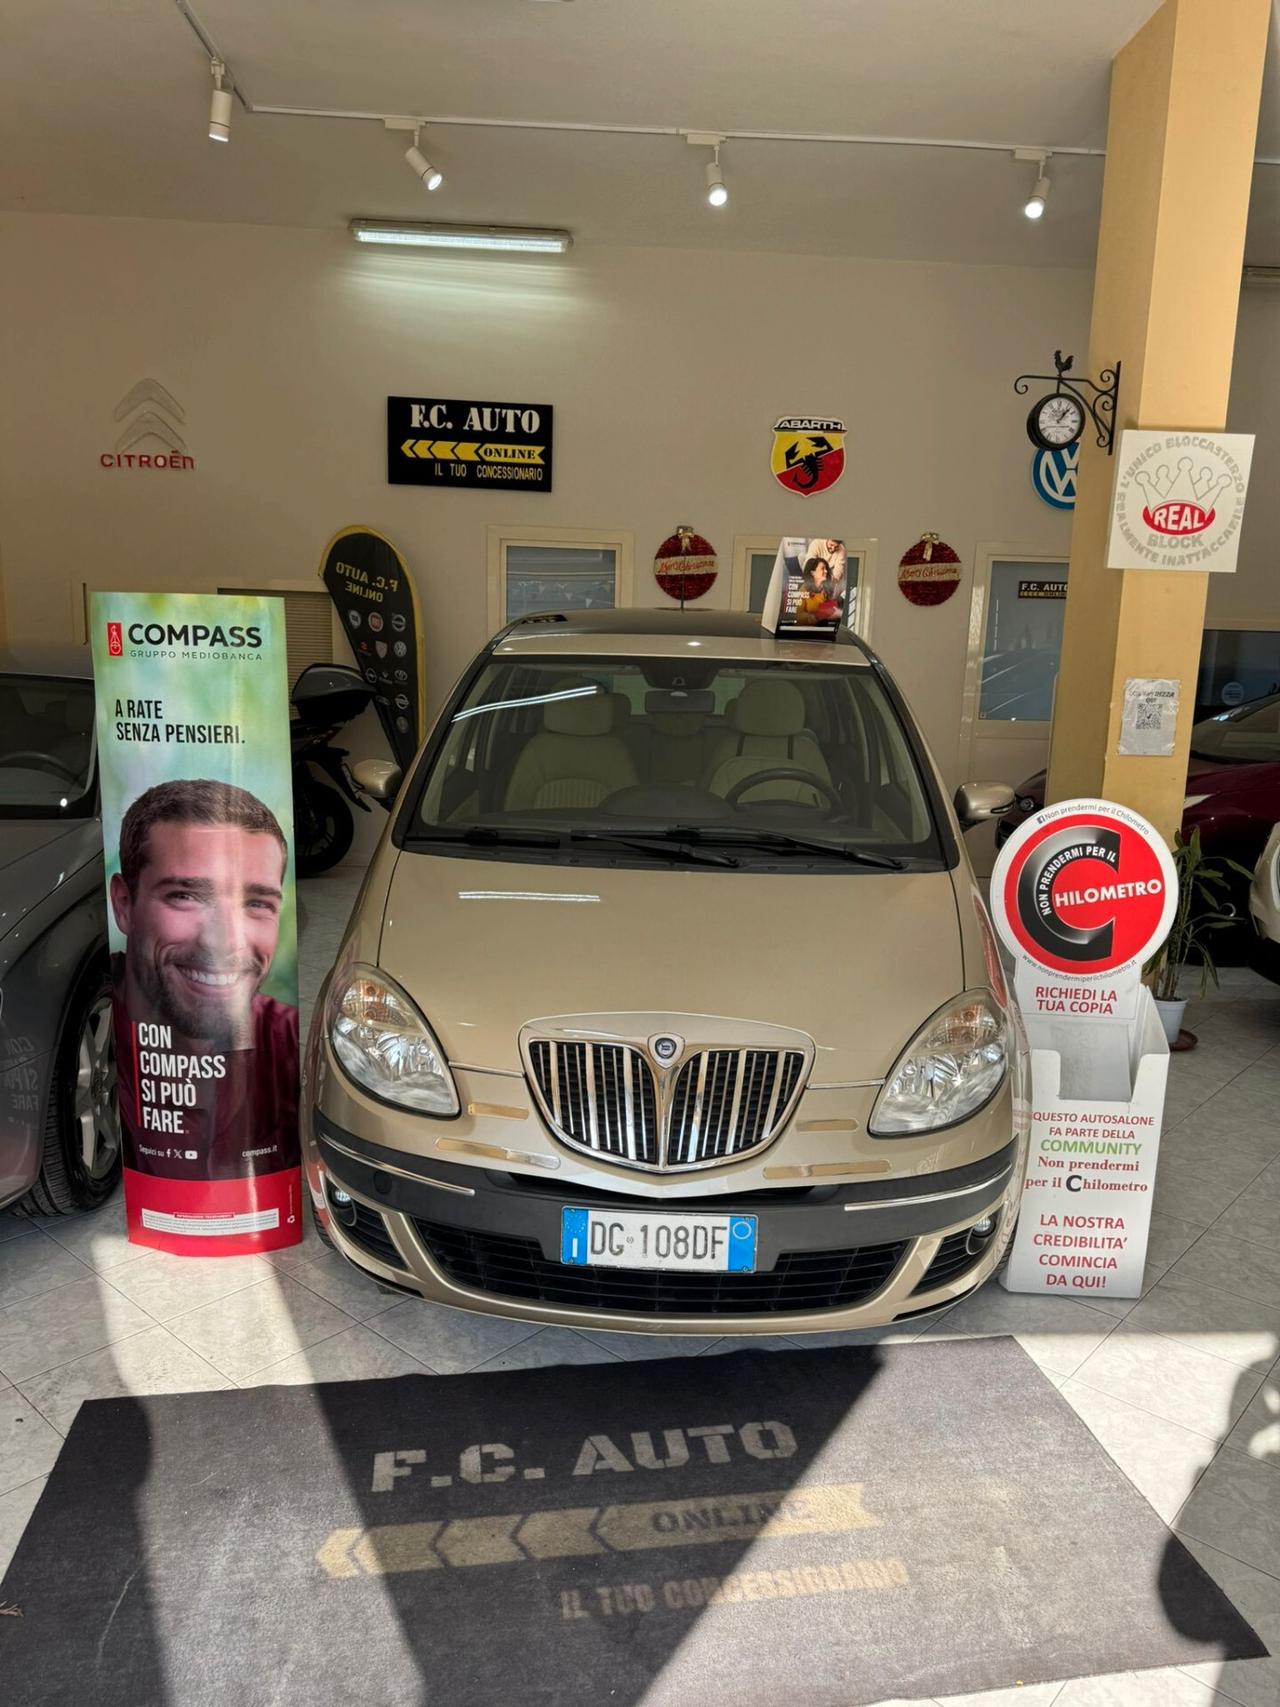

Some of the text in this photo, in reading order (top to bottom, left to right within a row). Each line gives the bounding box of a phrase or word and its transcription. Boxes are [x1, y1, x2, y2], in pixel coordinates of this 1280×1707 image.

[410, 404, 540, 434] F.C. AUTO
[780, 420, 841, 430] ABARTH
[483, 447, 536, 460] ONLINE
[434, 463, 543, 481] IL TUO CONCESSIONARIO
[1153, 505, 1204, 531] REAL
[1147, 534, 1204, 549] BLOCK
[128, 623, 262, 648] COMPASS
[130, 650, 262, 661] GRUPPO MEDIOBANCA
[115, 699, 163, 719] A RATE
[116, 722, 245, 744] SENZA PENSIERI.
[1044, 810, 1060, 821] Non
[1060, 804, 1098, 815] prendermi
[1098, 804, 1110, 813] per
[1116, 809, 1150, 836] Chilometro
[1038, 845, 1117, 916] NON PRENDERMI PER IL
[1035, 986, 1117, 1001] RICHIEDI LA
[1037, 1000, 1113, 1014] TUA COPIA
[138, 1022, 172, 1049] CON
[139, 1051, 226, 1079] COMPASS
[141, 1078, 197, 1107] SI PUÒ
[1033, 1111, 1078, 1122] QUESTO
[1080, 1113, 1155, 1126] AUTOSALONE
[1049, 1127, 1135, 1139] FA PARTE DELLA
[242, 1145, 278, 1158] compass.it
[1040, 1139, 1142, 1155] COMMUNITY
[1038, 1156, 1139, 1172] Non prendermi
[1025, 1174, 1148, 1193] per il Chilometro
[1040, 1214, 1125, 1229] LA NOSTRA
[590, 1221, 728, 1260] DG 108DF
[1033, 1233, 1127, 1249] CREDIBILITA'
[1039, 1254, 1118, 1269] COMINCIA
[1046, 1274, 1106, 1289] DA QUI!
[371, 1420, 798, 1493] F.C. AUTO
[651, 1498, 812, 1534] ONLINE
[560, 1558, 909, 1621] IL TUO CONCESSIONARIO
